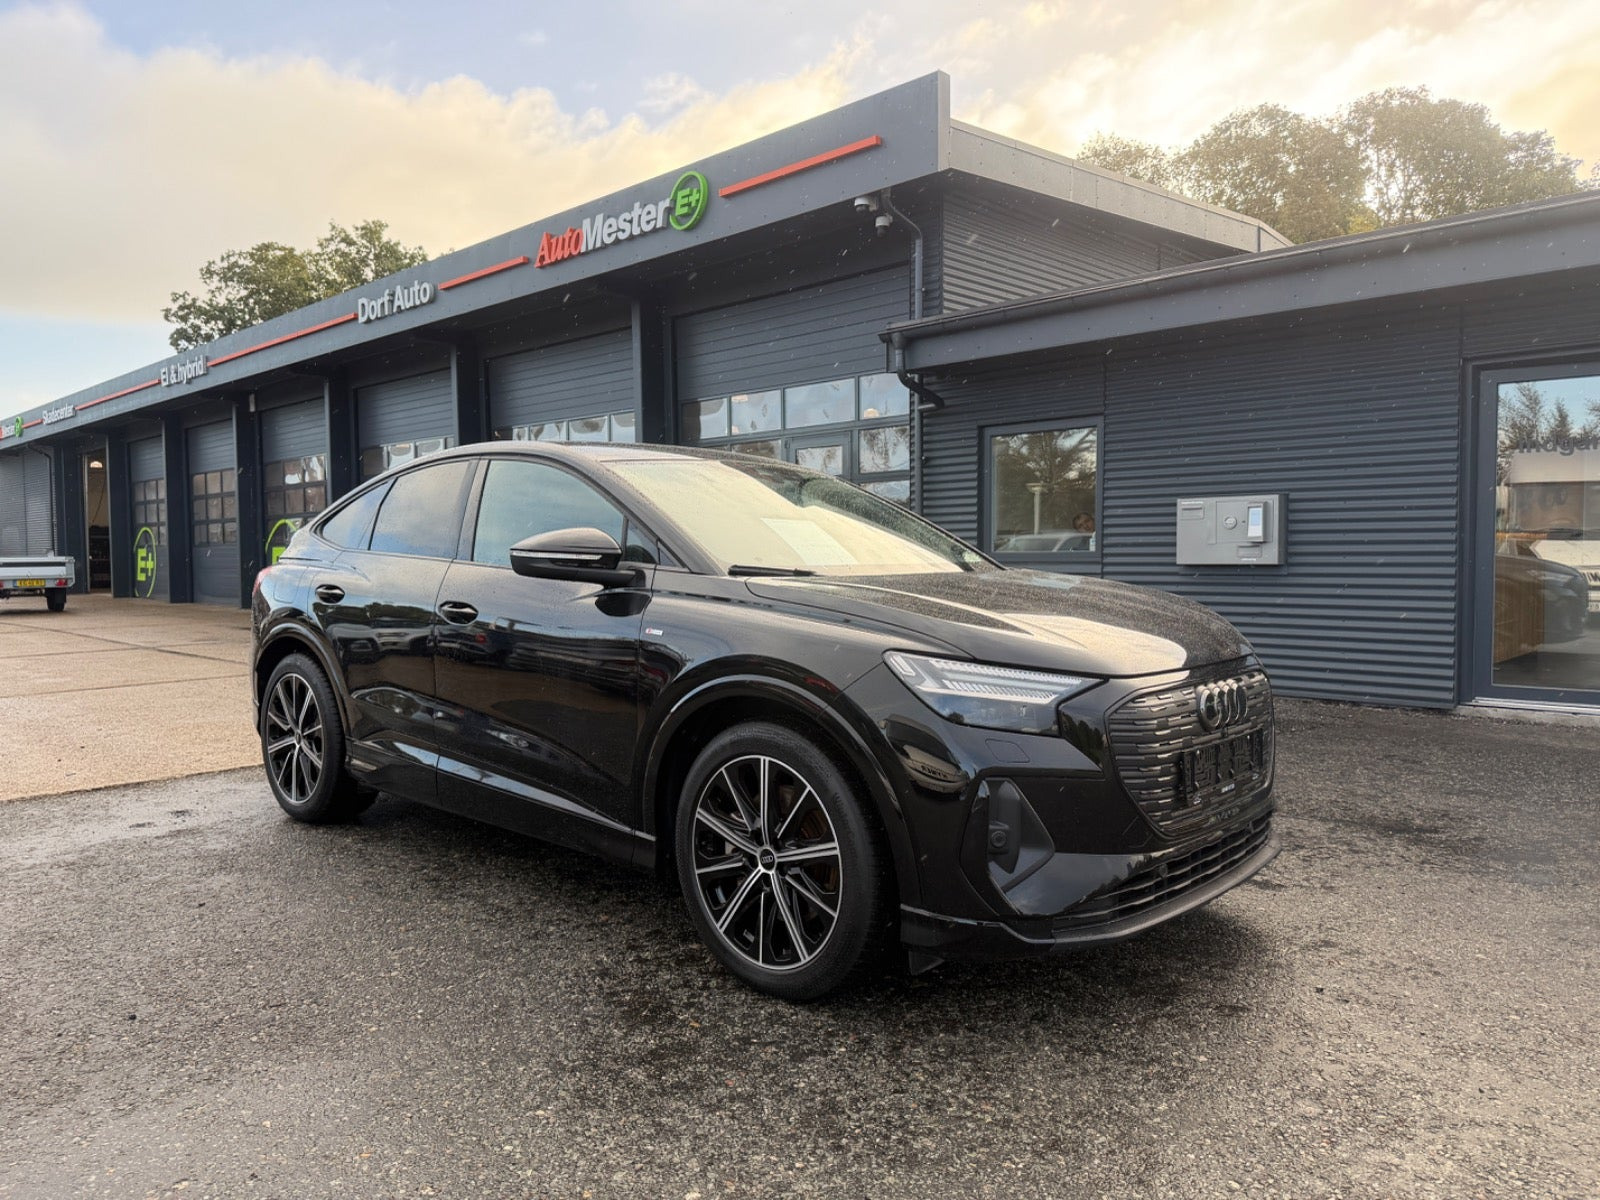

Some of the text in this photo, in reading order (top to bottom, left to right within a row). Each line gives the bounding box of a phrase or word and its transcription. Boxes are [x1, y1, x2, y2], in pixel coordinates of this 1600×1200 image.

[534, 187, 700, 268] AutoMester E+
[358, 280, 432, 323] Dorf Auto
[170, 364, 177, 384] &
[177, 355, 205, 384] hybrid
[137, 548, 154, 581] E+
